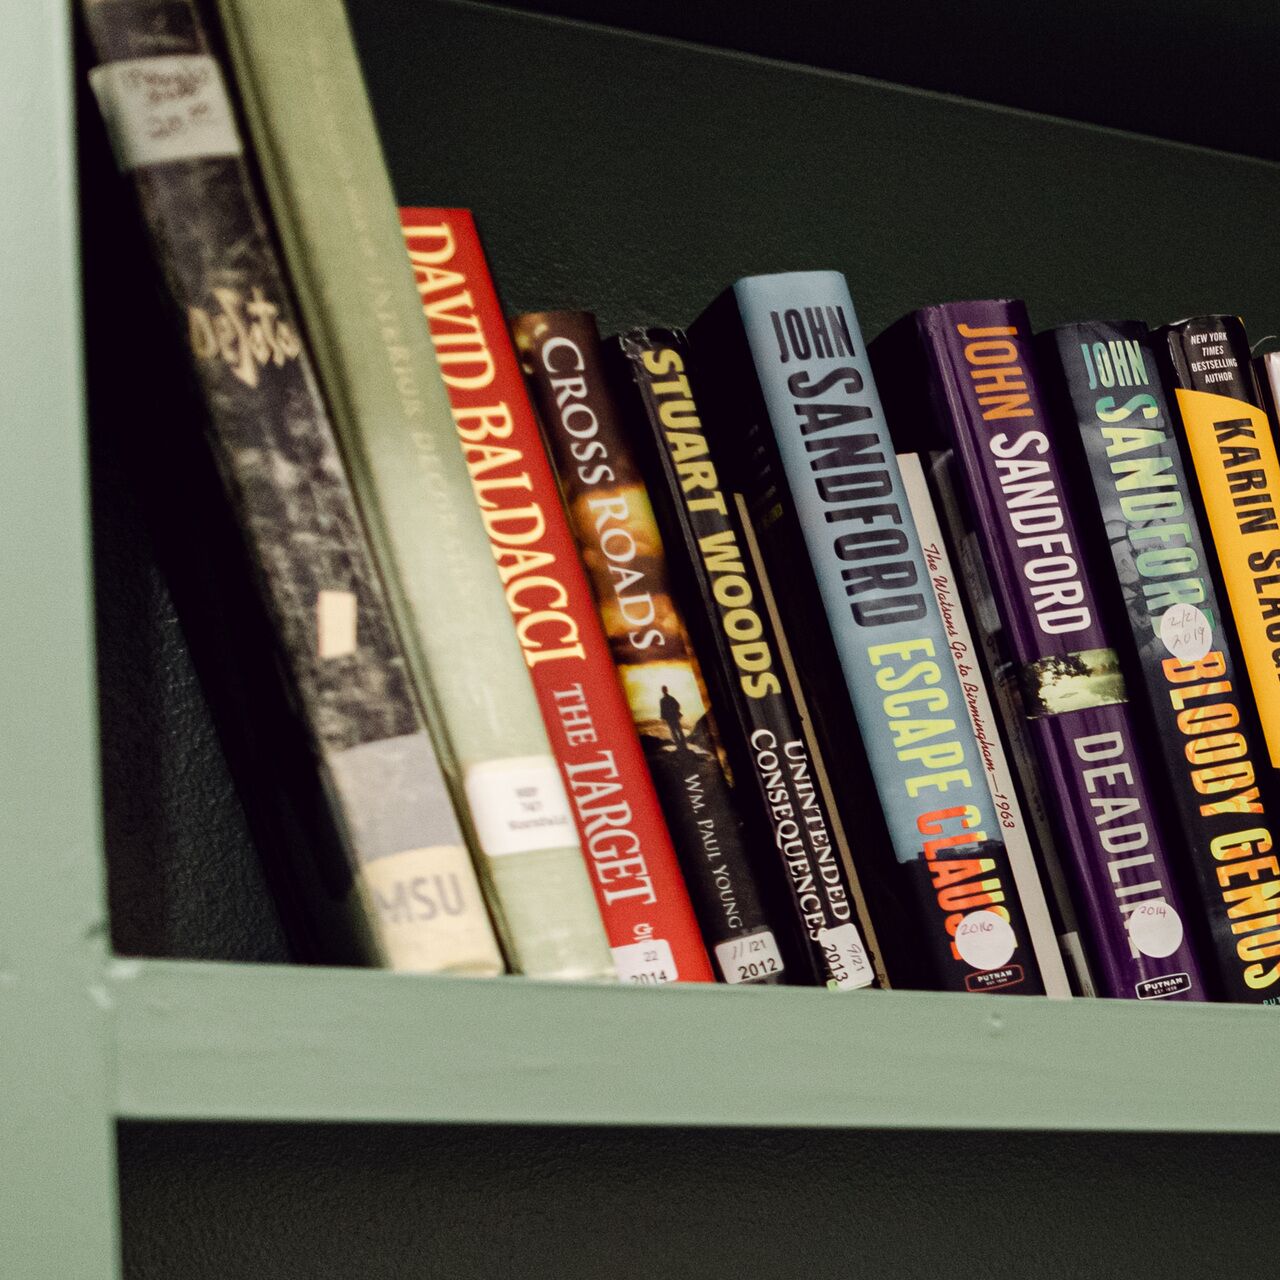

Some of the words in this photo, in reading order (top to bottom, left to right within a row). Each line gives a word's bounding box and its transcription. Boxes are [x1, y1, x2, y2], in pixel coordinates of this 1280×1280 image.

[770, 306, 856, 363] JOHN
[957, 323, 1035, 421] JOHN
[1080, 339, 1150, 391] JOHN
[1191, 333, 1208, 345] NEW
[1208, 332, 1228, 343] YORK
[1191, 358, 1238, 372] BESTSELLING
[1202, 345, 1224, 356] TIMES
[1204, 372, 1233, 383] AUTHOR
[402, 222, 496, 391] DAVID
[453, 400, 586, 668] BALDACCI
[541, 336, 616, 486] CROSS
[588, 493, 666, 651] ROADS
[1212, 418, 1280, 535] KARIN
[641, 348, 729, 517] STUART
[698, 530, 783, 700] WOODS
[787, 366, 928, 629] SANDFORD
[989, 430, 1092, 635] SANDFORD
[922, 543, 940, 572] The
[932, 575, 959, 645] Watsons
[950, 639, 967, 661] Go
[959, 662, 977, 680] to
[553, 682, 599, 747] THE
[868, 637, 973, 798] ESCAPE
[1161, 649, 1265, 817] BLOODY
[564, 750, 657, 907] TARGET
[684, 773, 700, 815] WM.
[697, 818, 721, 862] PAUL
[712, 864, 744, 930] YOUNG
[784, 740, 851, 921] UNINTENDED
[1074, 730, 1166, 960] DEADLI
[373, 873, 467, 924] MSU
[961, 921, 994, 935] 2016
[738, 958, 778, 980] 2012
[824, 944, 848, 982] 2013
[977, 970, 1013, 982] PUTNAM
[1144, 976, 1183, 991] PUTNAM
